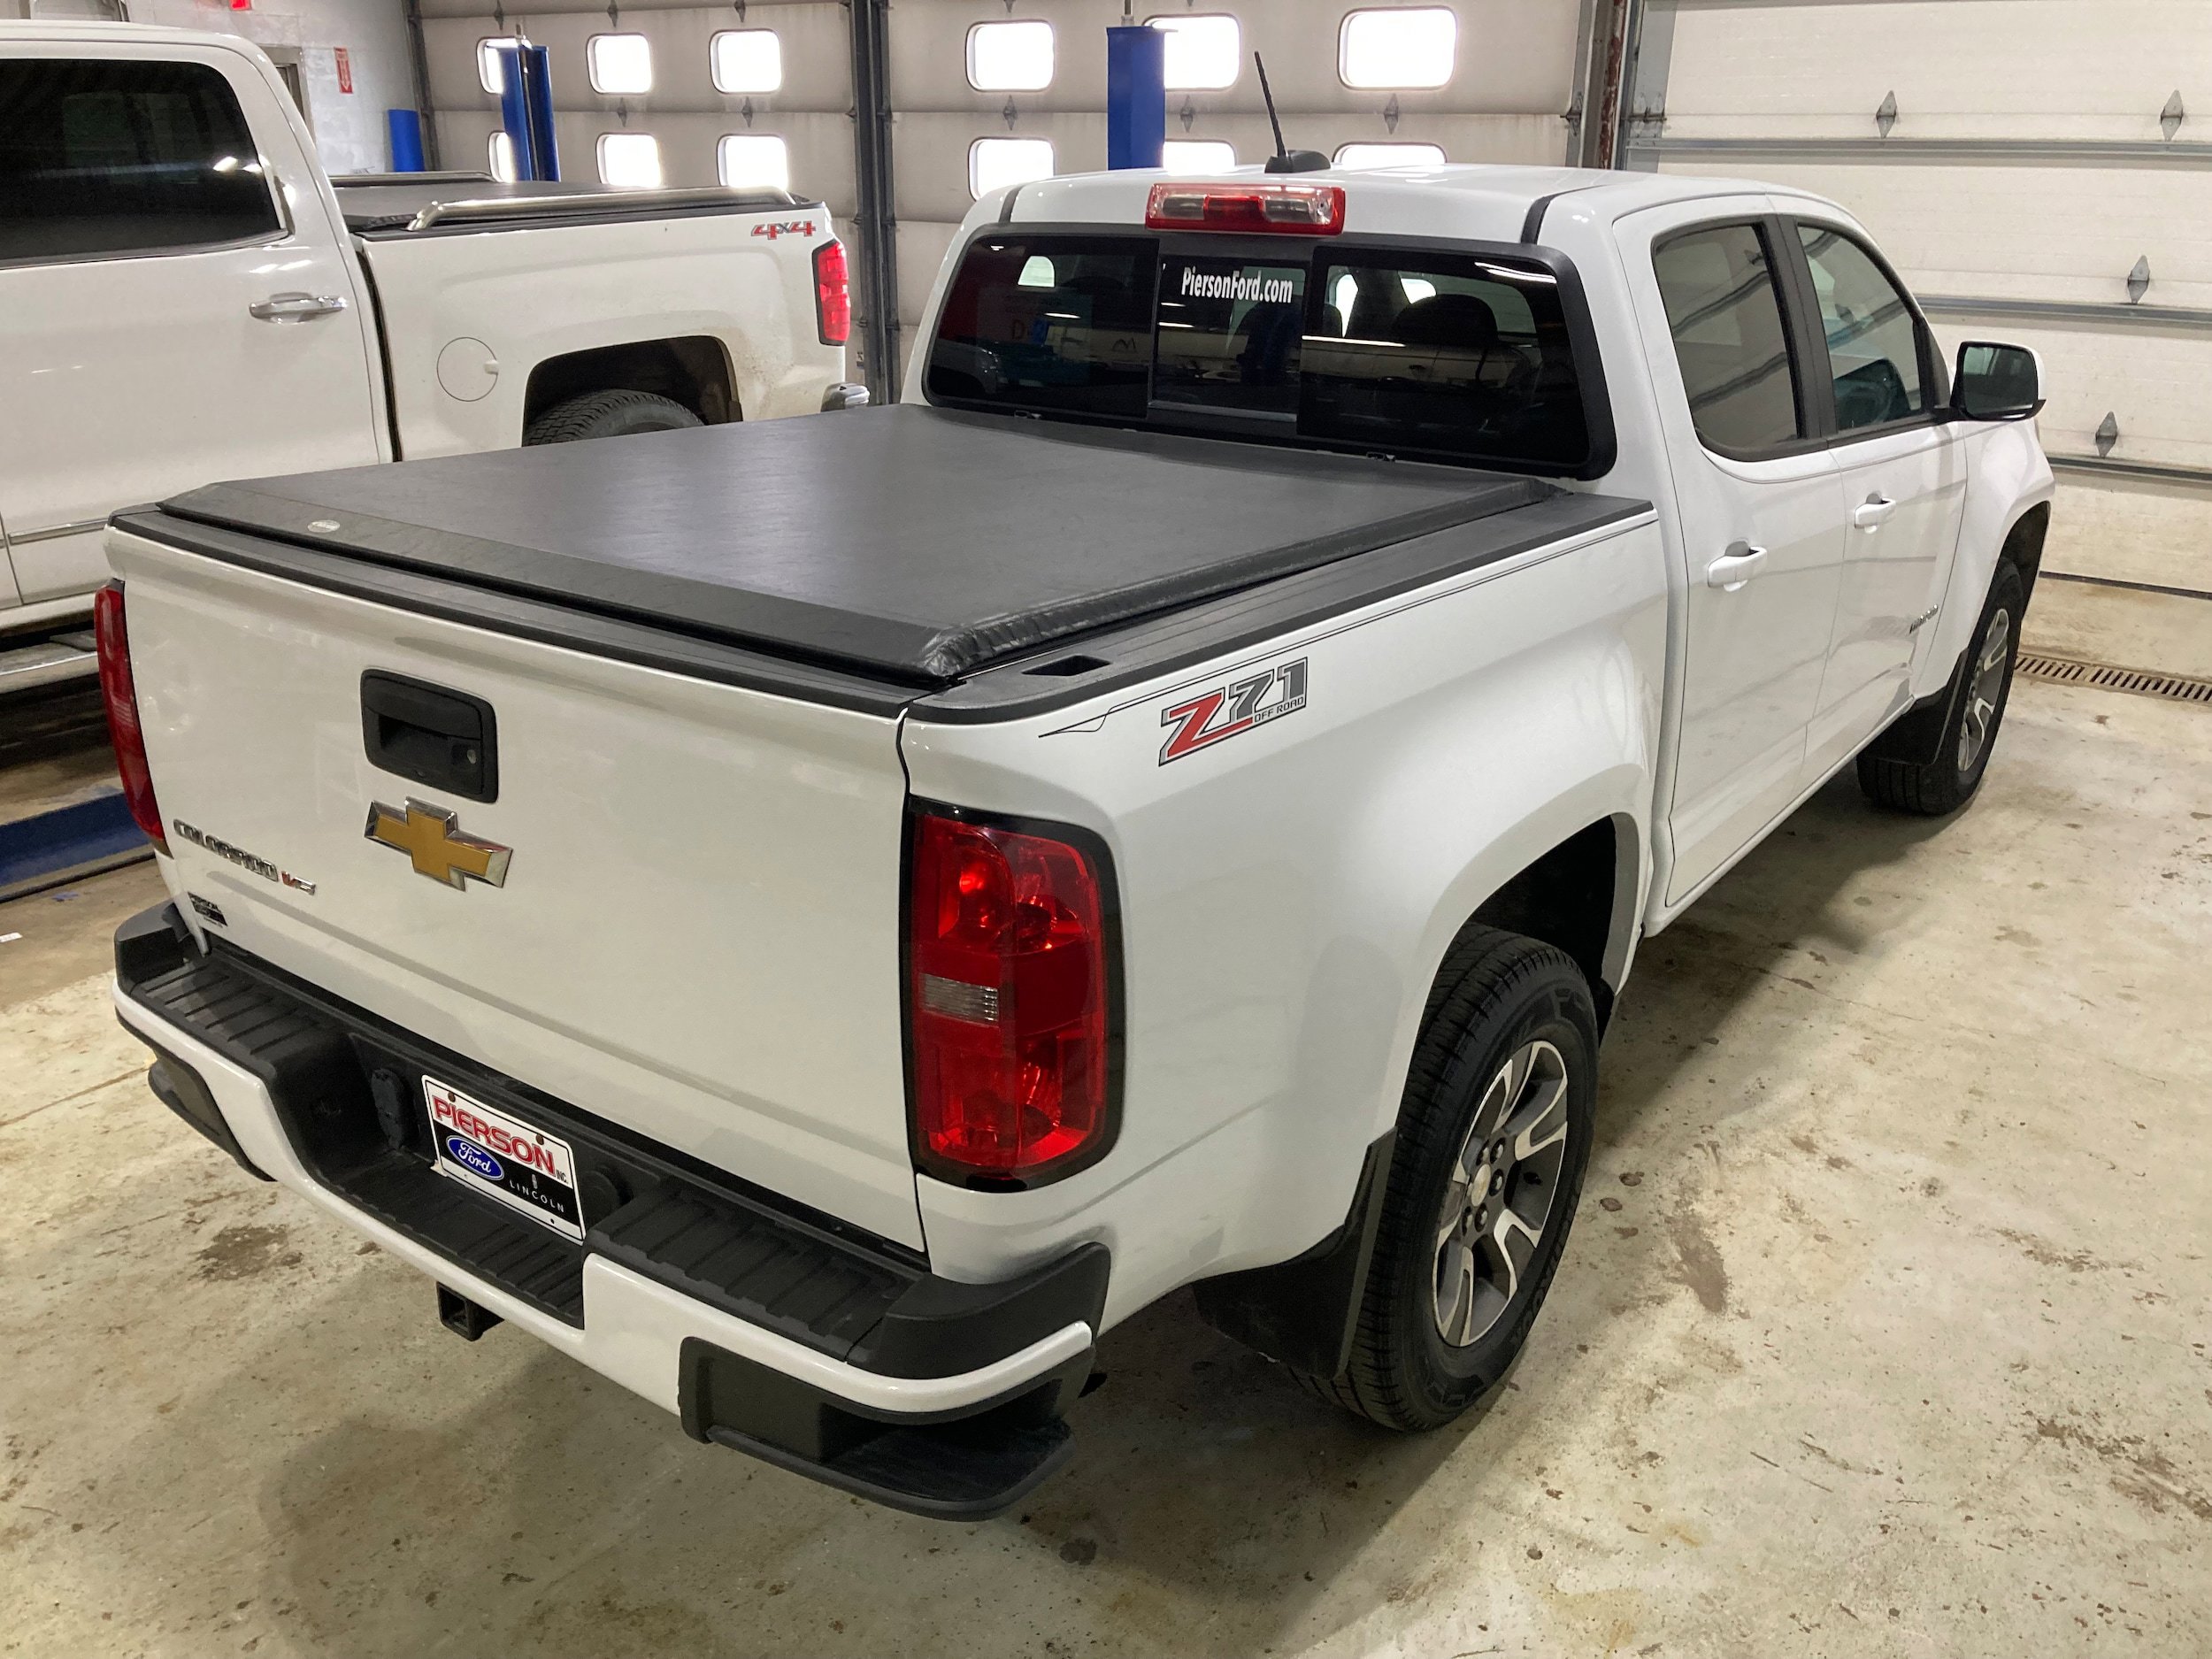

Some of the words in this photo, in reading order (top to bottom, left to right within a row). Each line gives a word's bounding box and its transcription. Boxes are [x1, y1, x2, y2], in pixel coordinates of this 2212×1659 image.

[1181, 266, 1294, 303] PiersonFord.com
[1158, 657, 1308, 767] Z71
[1254, 709, 1275, 723] OFF
[1276, 696, 1304, 713] ROAD
[431, 1096, 557, 1176] PIERSON
[457, 1141, 492, 1173] Ford
[509, 1179, 565, 1212] LINCOLN
